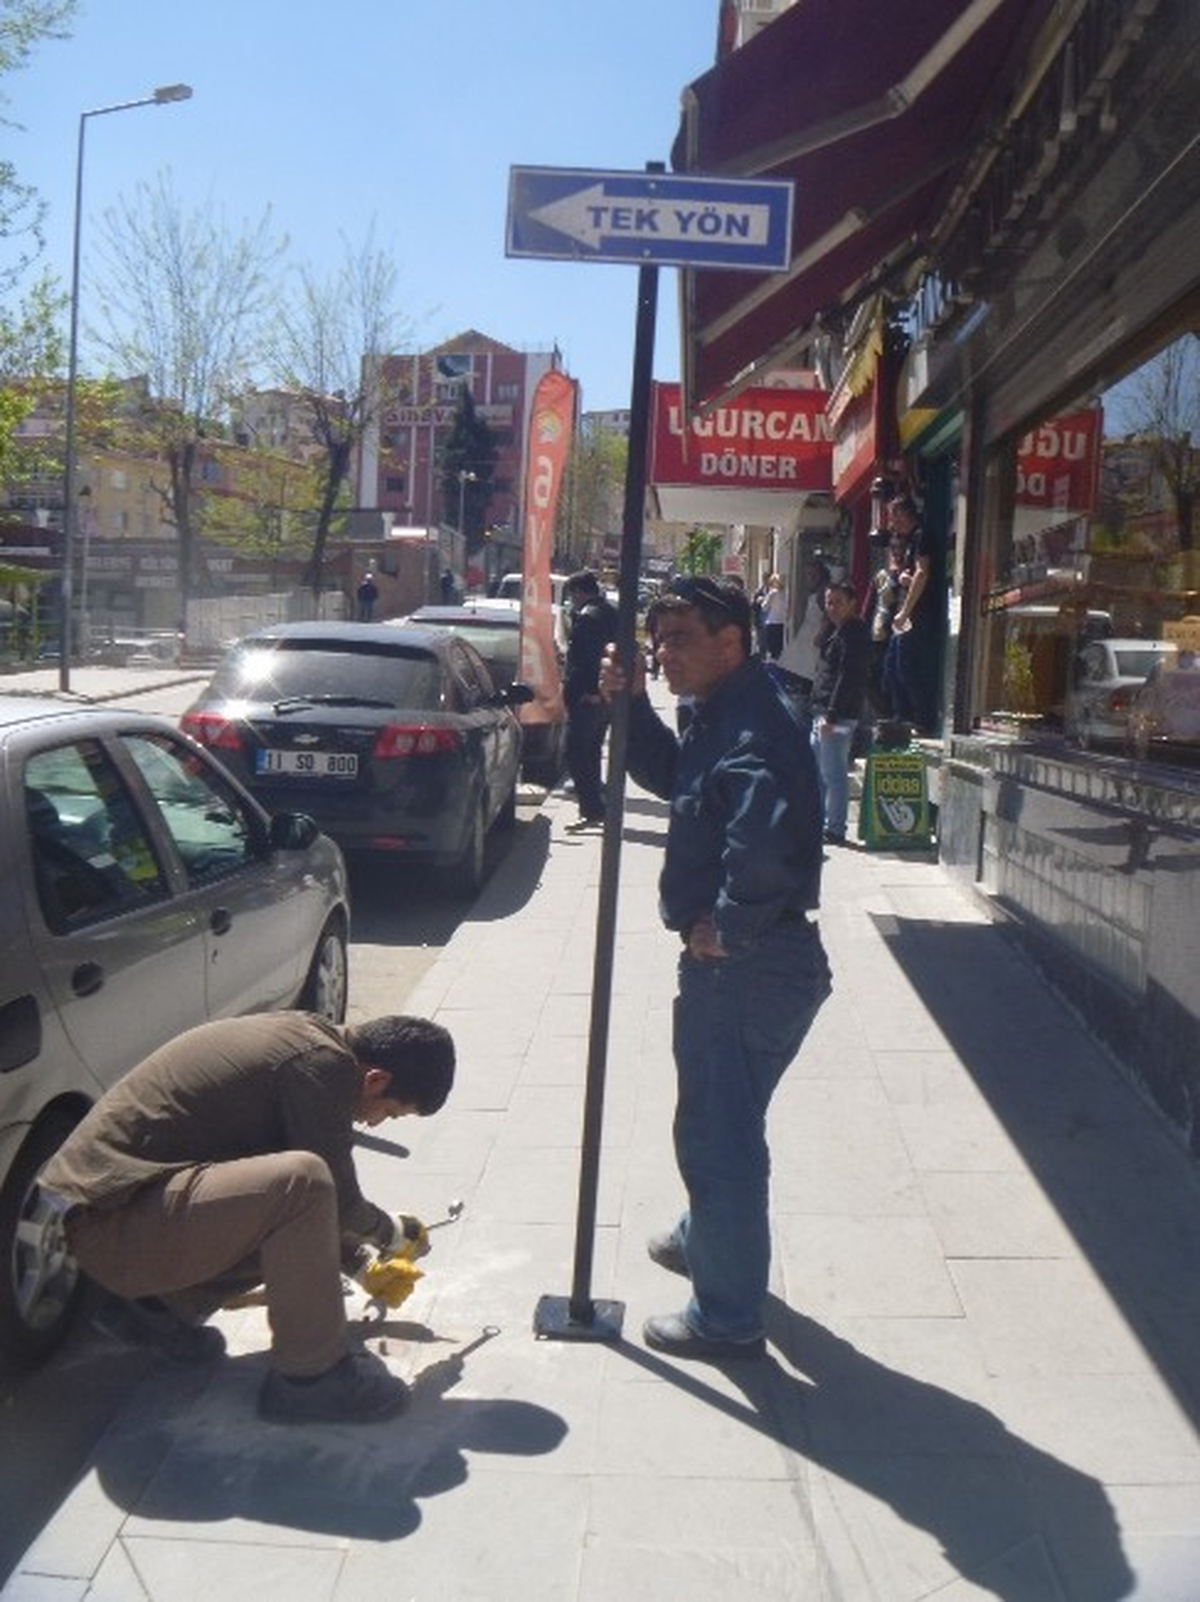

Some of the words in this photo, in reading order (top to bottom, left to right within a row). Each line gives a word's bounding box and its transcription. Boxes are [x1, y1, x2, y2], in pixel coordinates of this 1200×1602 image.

[587, 206, 660, 232] TEK
[674, 207, 750, 237] YÖN
[701, 447, 797, 479] DÖNER
